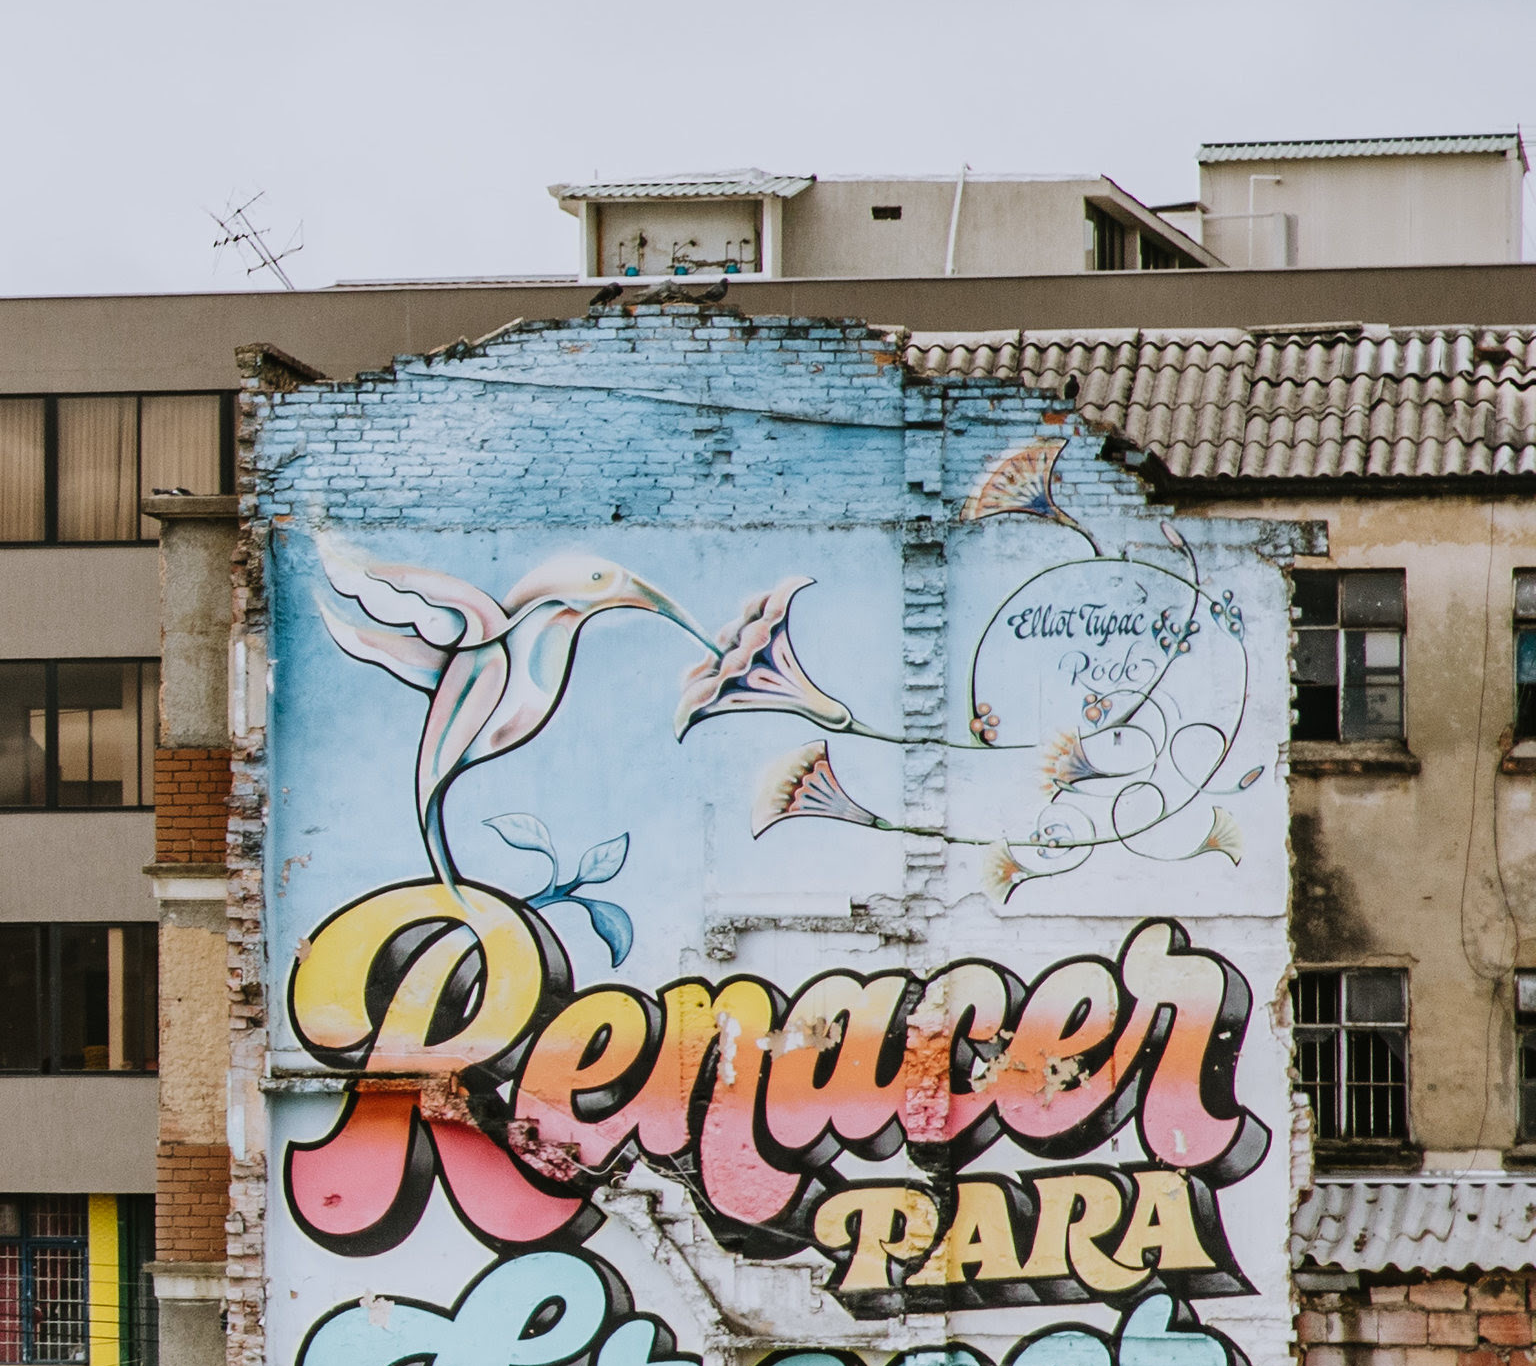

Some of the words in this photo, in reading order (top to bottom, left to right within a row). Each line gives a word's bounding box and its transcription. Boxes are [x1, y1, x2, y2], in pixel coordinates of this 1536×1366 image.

[1007, 603, 1076, 640] Elliot
[1079, 603, 1147, 647] Tupac
[282, 882, 1272, 1257] Renacer
[814, 1167, 1240, 1313] PARA
